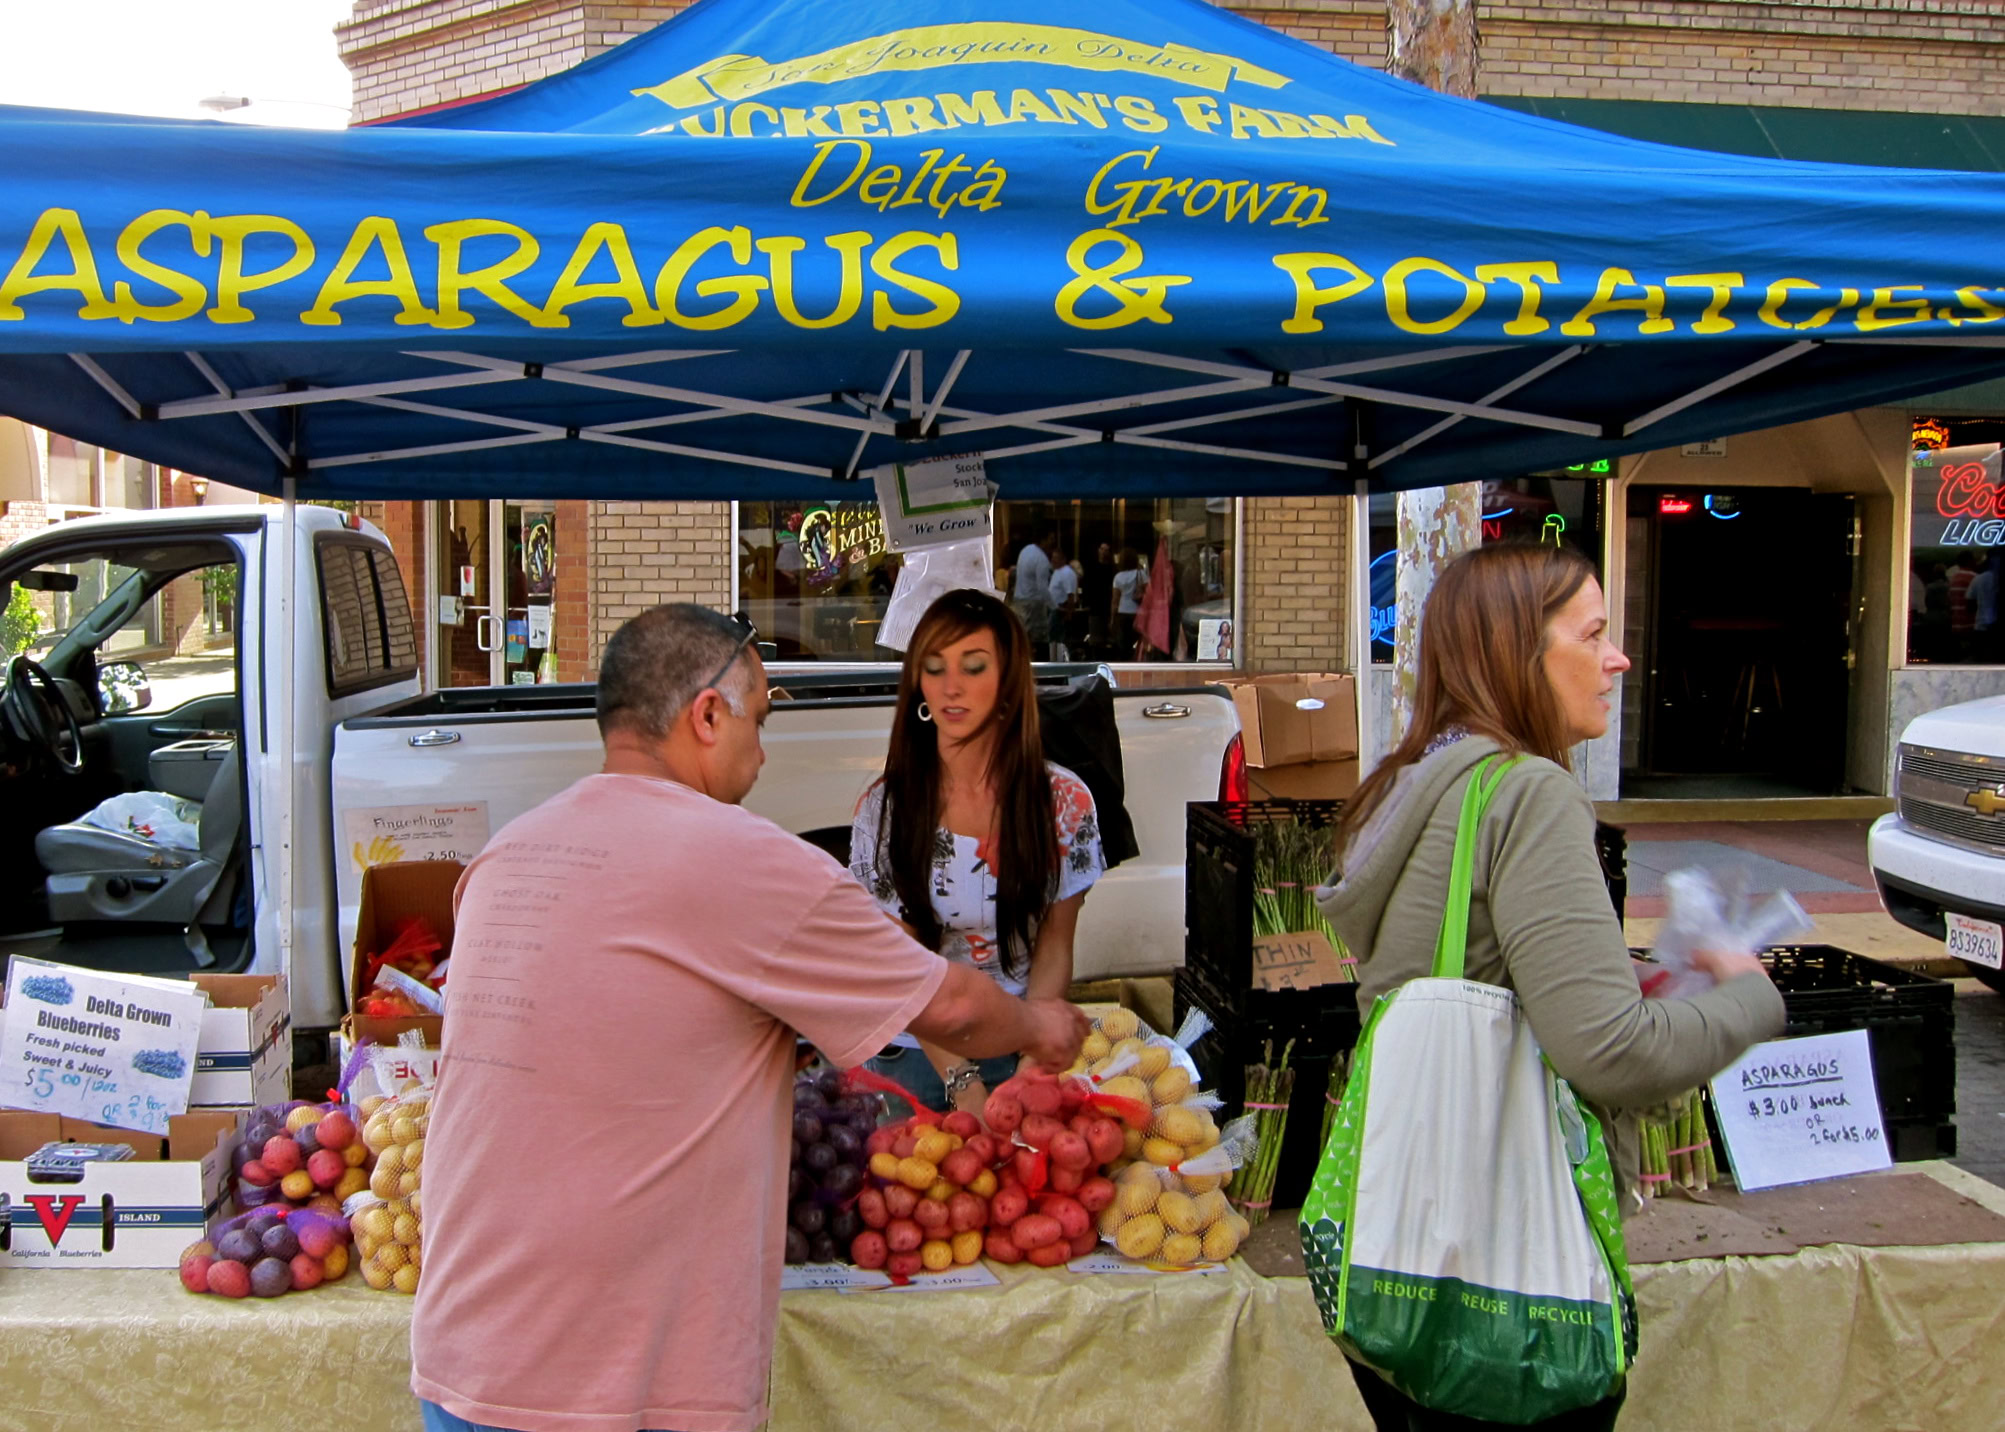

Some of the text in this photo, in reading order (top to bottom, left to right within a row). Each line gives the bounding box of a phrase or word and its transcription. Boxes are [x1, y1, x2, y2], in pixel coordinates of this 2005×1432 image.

[846, 38, 1060, 73] Joaquin
[1076, 39, 1210, 74] Delta
[634, 89, 1168, 137] UCKERMAN'S
[791, 139, 1330, 228] Delta Grown
[0, 209, 2005, 336] ASPARAGUS & POTATOES
[953, 478, 971, 488] San
[939, 518, 977, 531] Grow
[373, 815, 454, 831] Fingerlings
[1253, 941, 1312, 965] THIN
[86, 995, 172, 1028] Delta Grown
[37, 1010, 121, 1042] Blueberries
[25, 1032, 106, 1058] Fresh picked
[22, 1051, 113, 1079] Sweet & Juicy
[1741, 1058, 1840, 1087] ASPARAGUS
[1805, 1113, 1826, 1130] OR
[118, 1213, 161, 1223] ISLAND
[11, 1249, 103, 1259] California Blueberries
[1372, 1279, 1438, 1302] REDUCE
[1460, 1292, 1508, 1316] REUSE
[1528, 1306, 1593, 1326] RECYCLE
